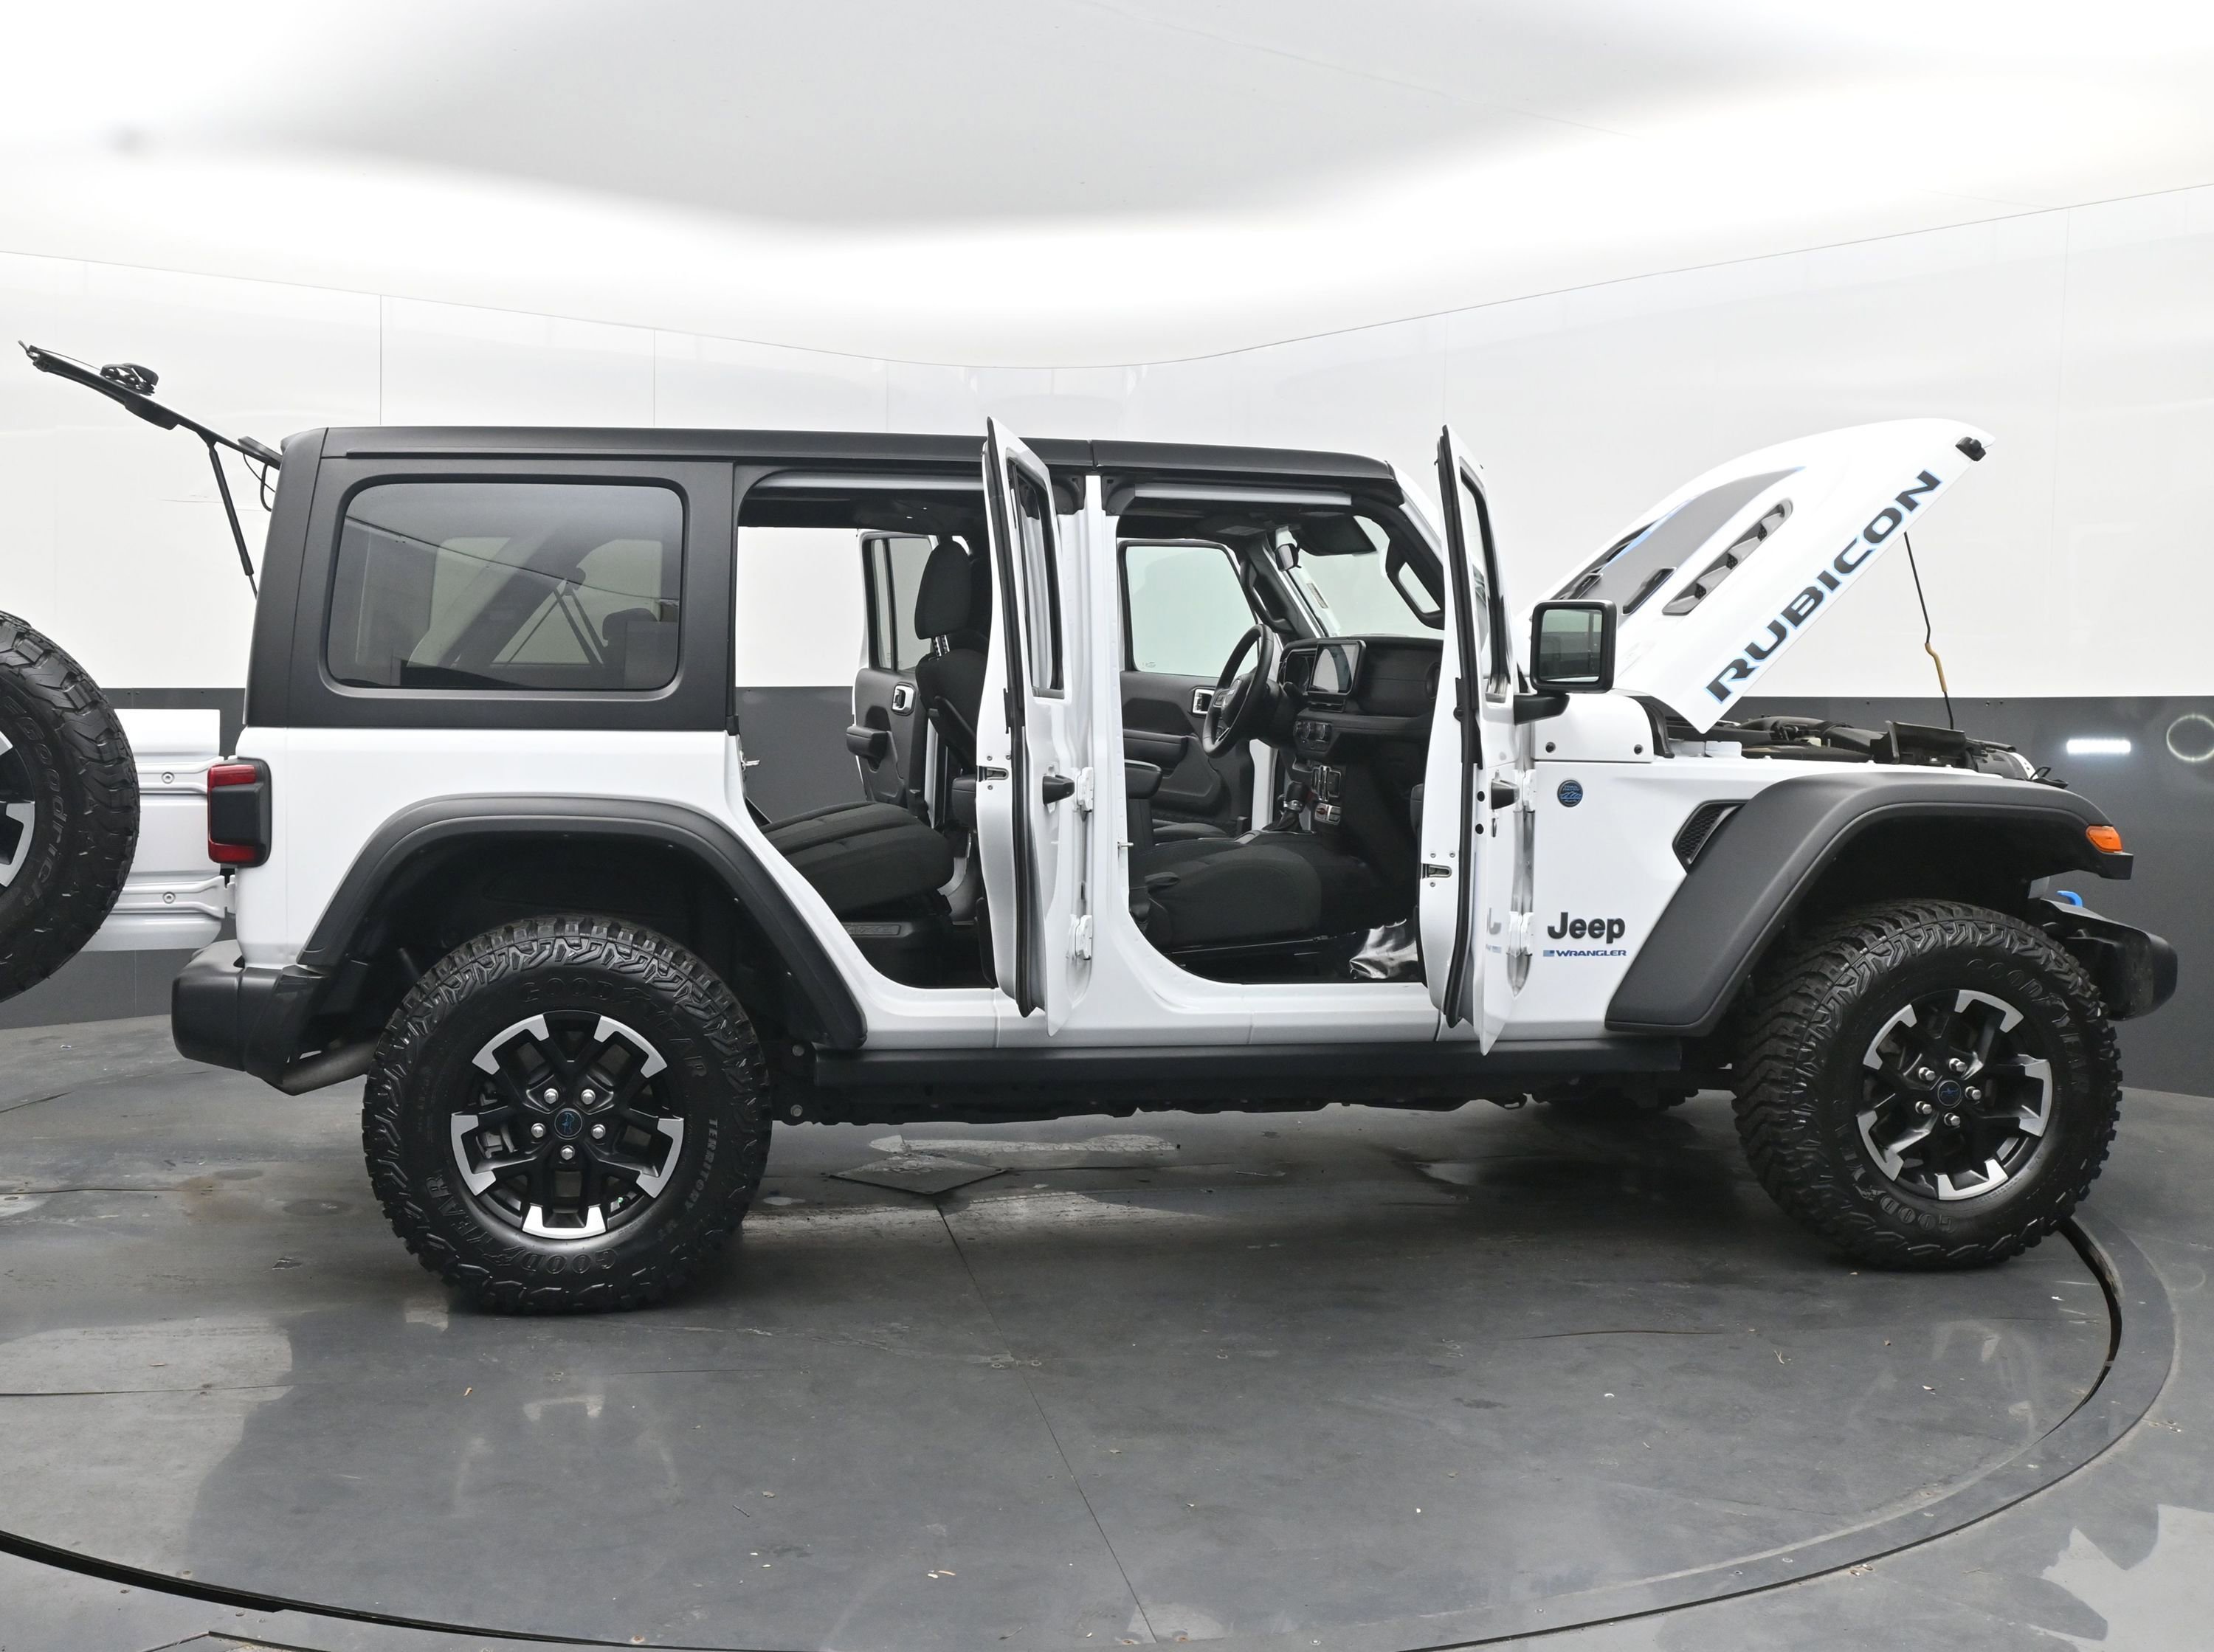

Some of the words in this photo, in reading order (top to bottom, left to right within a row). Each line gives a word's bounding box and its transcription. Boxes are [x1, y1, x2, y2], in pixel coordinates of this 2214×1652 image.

[1703, 468, 1942, 705] RUBICON
[1547, 911, 1626, 944] Jeep
[1555, 949, 1627, 957] WRANGLER
[683, 1118, 719, 1212] TERRITORY
